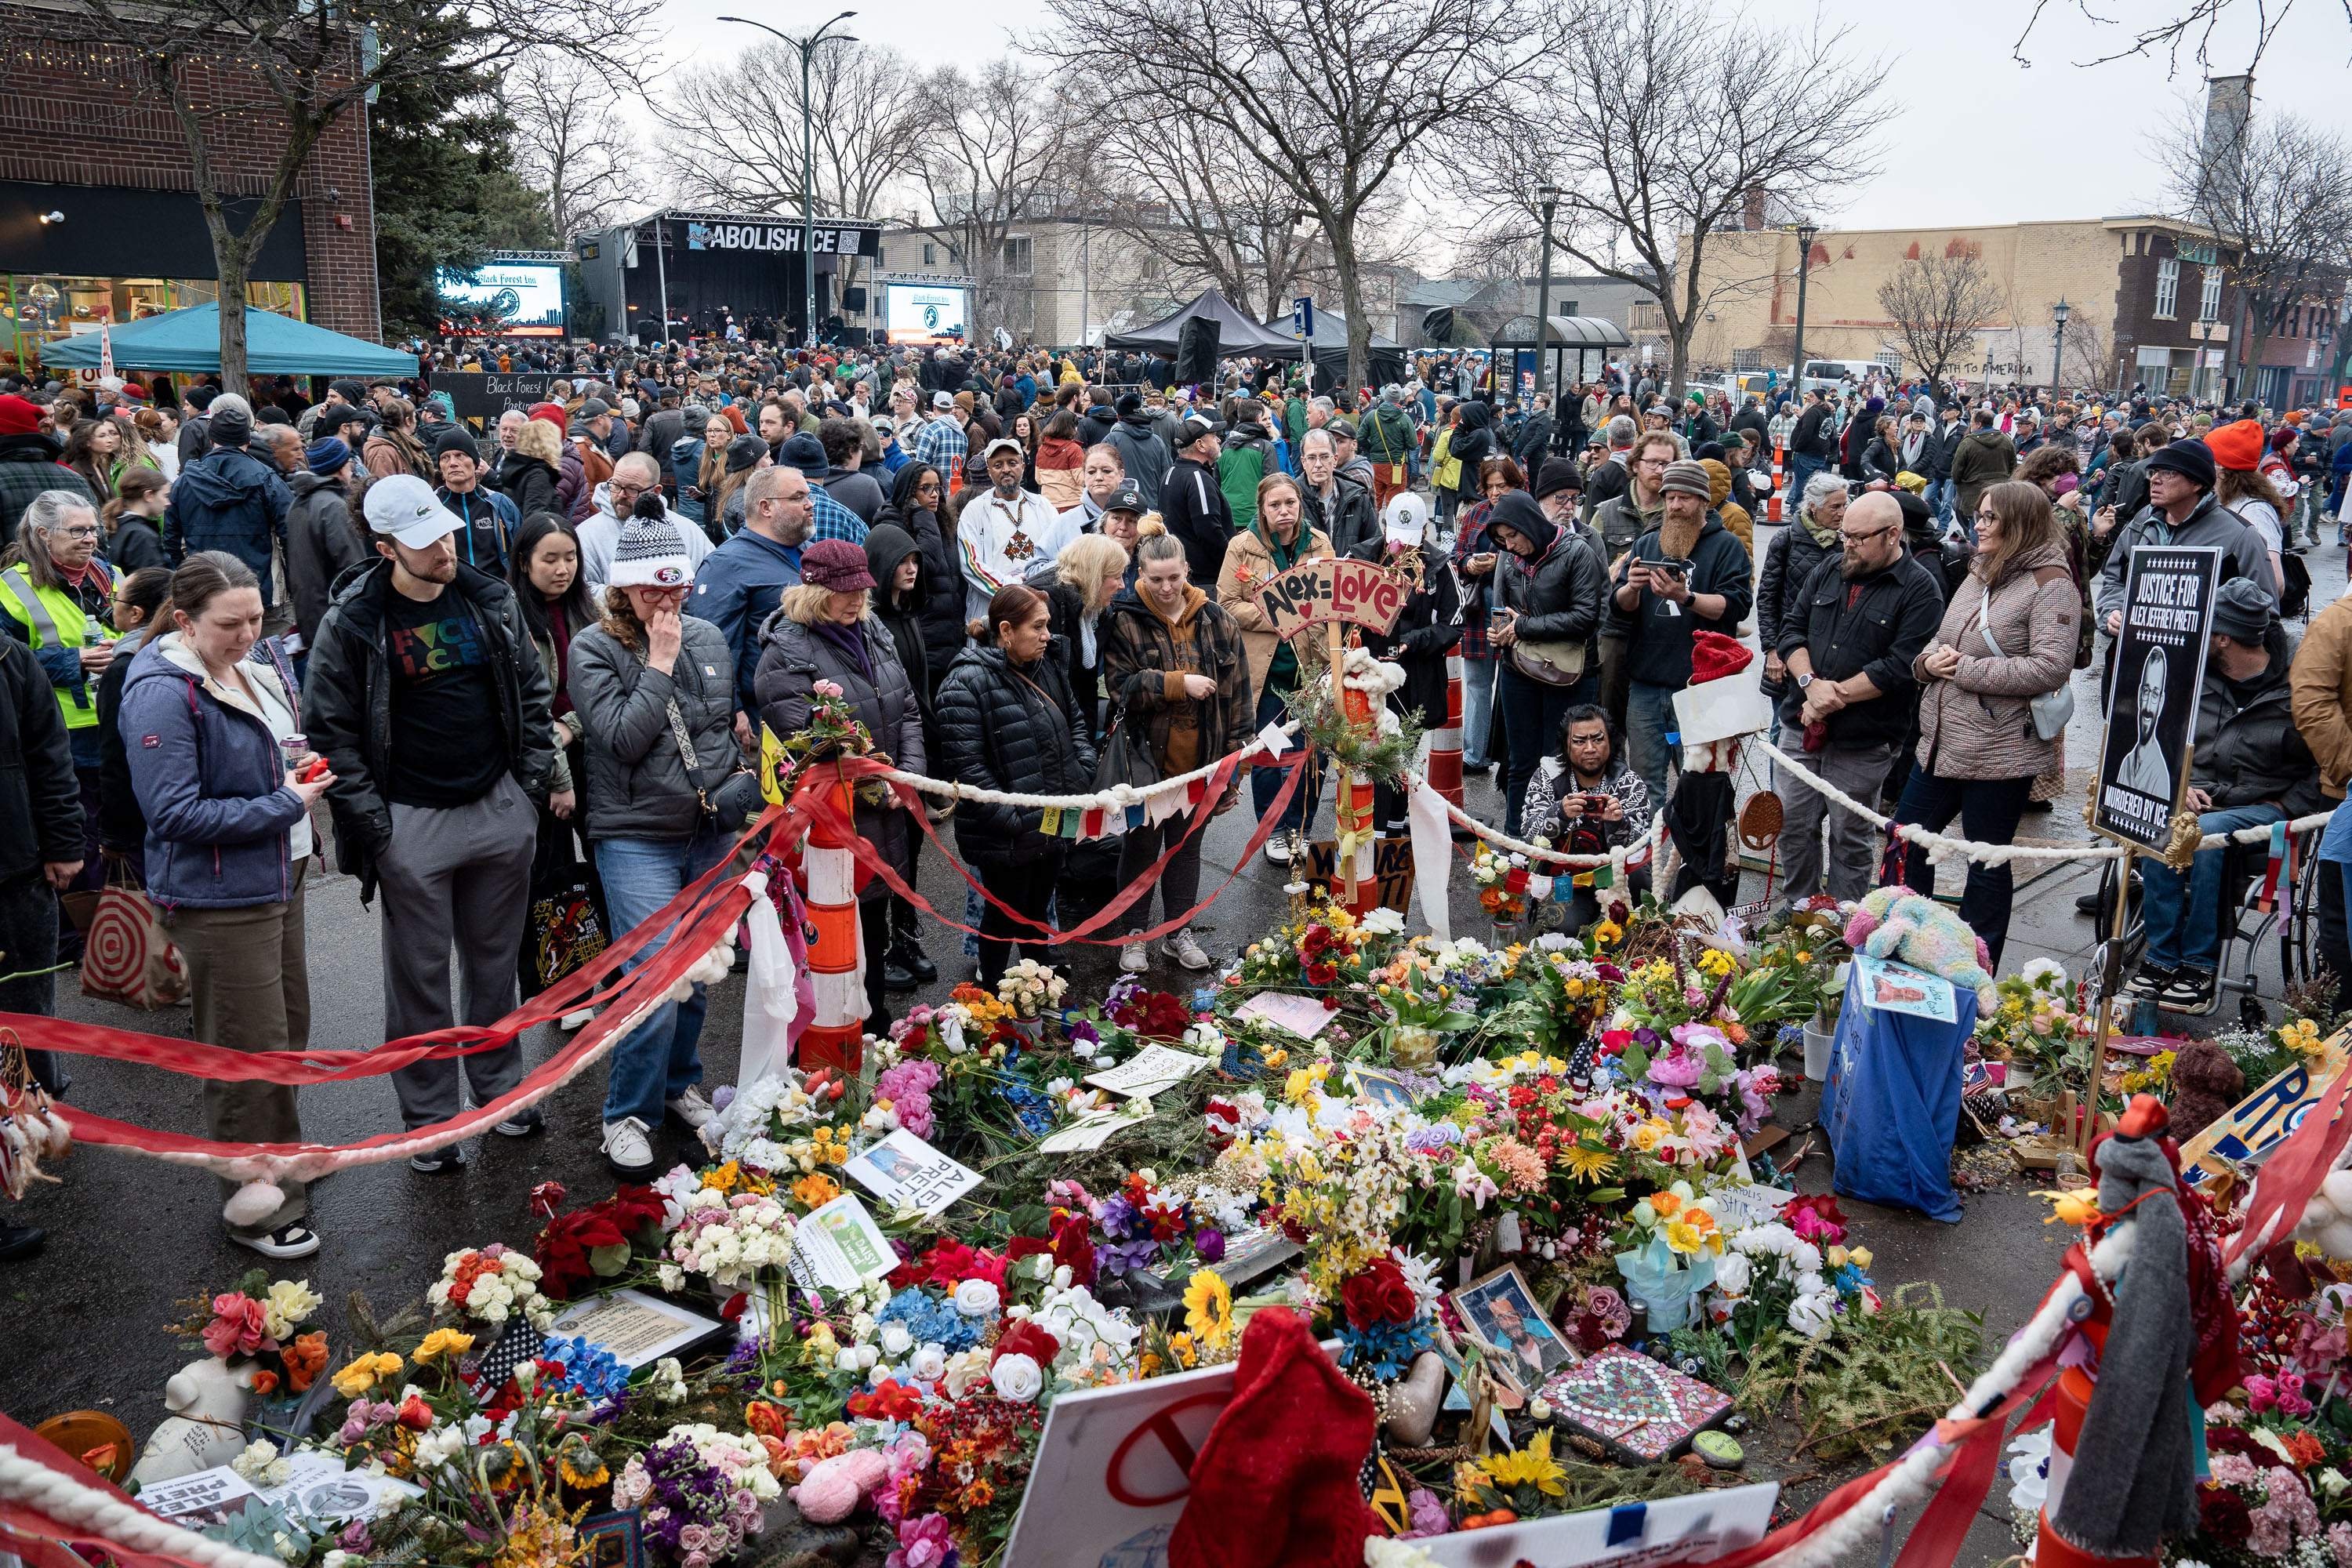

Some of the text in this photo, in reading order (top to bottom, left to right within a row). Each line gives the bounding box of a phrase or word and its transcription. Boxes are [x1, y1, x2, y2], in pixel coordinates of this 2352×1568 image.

[710, 226, 800, 251] ABOLISH
[499, 274, 522, 285] Forest
[524, 274, 536, 285] Inn
[1964, 363, 1978, 374] TO
[487, 376, 512, 394] Black
[2136, 573, 2200, 607] JUSTICE FOR
[2129, 605, 2199, 633] ALEX JEFFREY PRETTI
[2104, 785, 2169, 829] MURDERED BY ICE
[1726, 903, 1760, 917] STREETS
[1145, 1047, 1164, 1065] ALEX
[841, 1239, 862, 1265] Award
[855, 1239, 878, 1267] DAISY
[140, 1479, 228, 1504] PRETT
